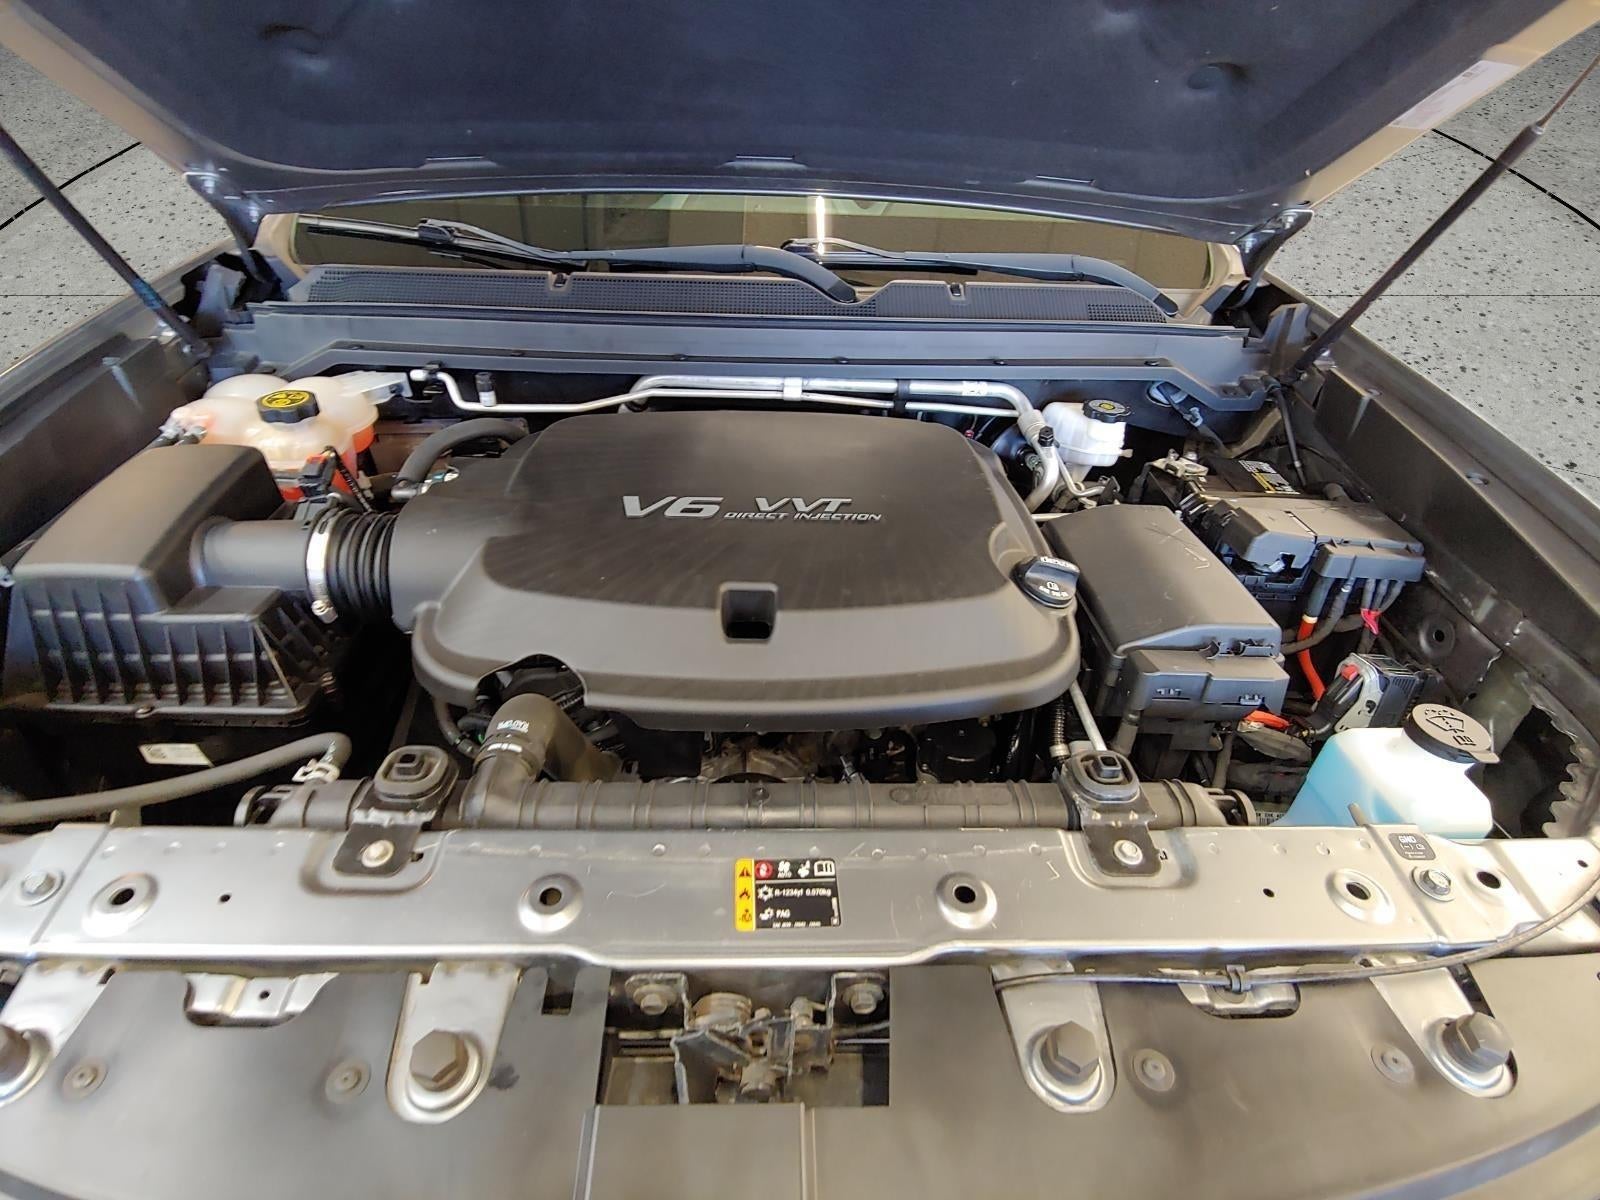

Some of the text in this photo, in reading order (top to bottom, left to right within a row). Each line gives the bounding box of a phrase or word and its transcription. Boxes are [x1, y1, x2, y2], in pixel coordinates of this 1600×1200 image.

[622, 495, 852, 518] V6 VVT
[723, 511, 882, 522] DIRECT INJECTION
[1398, 835, 1417, 844] GND
[775, 908, 791, 919] PAG
